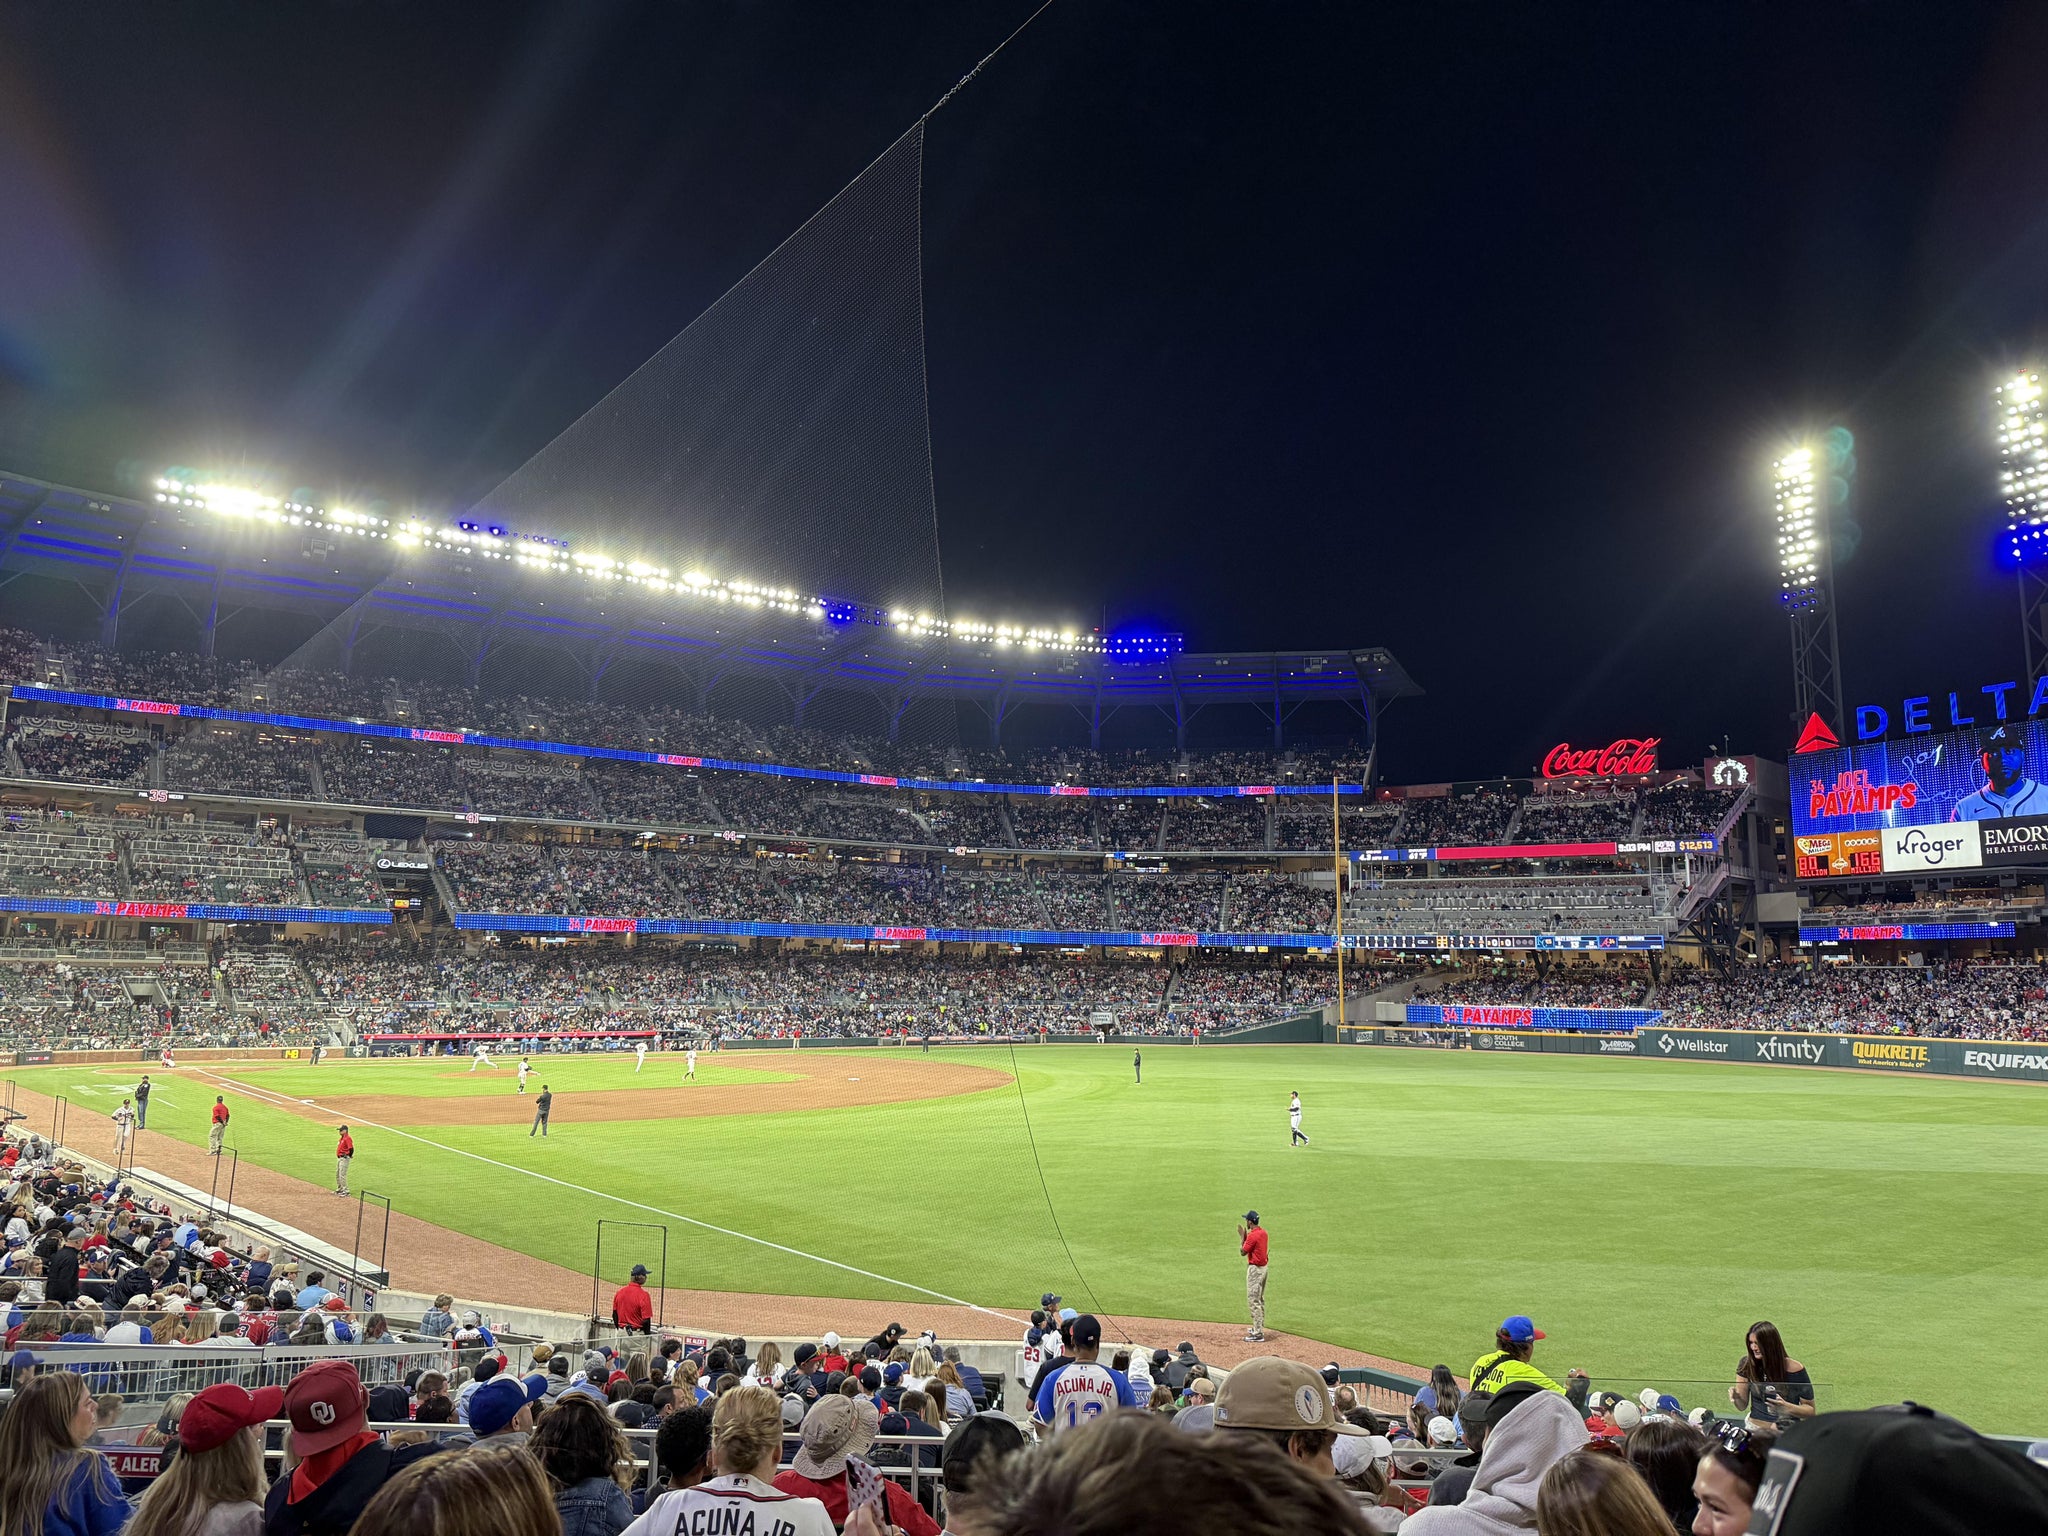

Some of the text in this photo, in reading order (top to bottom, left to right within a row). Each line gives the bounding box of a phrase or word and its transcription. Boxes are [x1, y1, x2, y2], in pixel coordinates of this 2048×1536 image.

[130, 699, 181, 716] PAYAMPS
[422, 729, 465, 744] PAYAMPS
[667, 755, 702, 767] PAYAMPS
[1541, 737, 1661, 779] Coca-Cola
[1810, 769, 1873, 794] 34 JOEL
[149, 789, 168, 802] 35
[1810, 782, 1917, 818] PAYAMPS
[466, 812, 480, 823] 41
[723, 830, 736, 841] 44
[1618, 842, 1637, 852] 9:03
[1637, 843, 1651, 852] PM
[1679, 840, 1713, 851] $12,513
[1897, 829, 1964, 865] Kroger
[1986, 843, 2048, 855] HEALTHCAR
[391, 861, 429, 869] LEXUS
[1855, 852, 1881, 866] 166
[1851, 865, 1881, 874] MILLION
[1425, 889, 1474, 906] HANK
[1549, 888, 1635, 906] TERRACE
[115, 902, 187, 918] PAYAMPS
[584, 918, 637, 933] PAYAMPS
[1852, 926, 1903, 940] PAYAMPS
[885, 928, 927, 940] PAYAMPS
[1153, 934, 1198, 946] PAYAMPS
[1442, 1007, 1533, 1025] 34 PAYAMPS
[1494, 1040, 1525, 1048] COLLEGE
[1676, 1038, 1729, 1053] Wellstar
[1756, 1036, 1825, 1063] xfinity
[1852, 1041, 1929, 1062] QUIKRETE
[1872, 1059, 1899, 1067] America's
[1964, 1050, 2048, 1071] EQUIFAX
[693, 1338, 705, 1346] ALERT
[1024, 1346, 1040, 1363] 23
[1473, 1365, 1504, 1384] VEOR
[1056, 1375, 1094, 1397] ACUÑA
[1097, 1380, 1112, 1399] JR.
[310, 1401, 336, 1425] OU
[121, 1456, 160, 1472] ALER
[674, 1500, 755, 1536] ACUÑA
